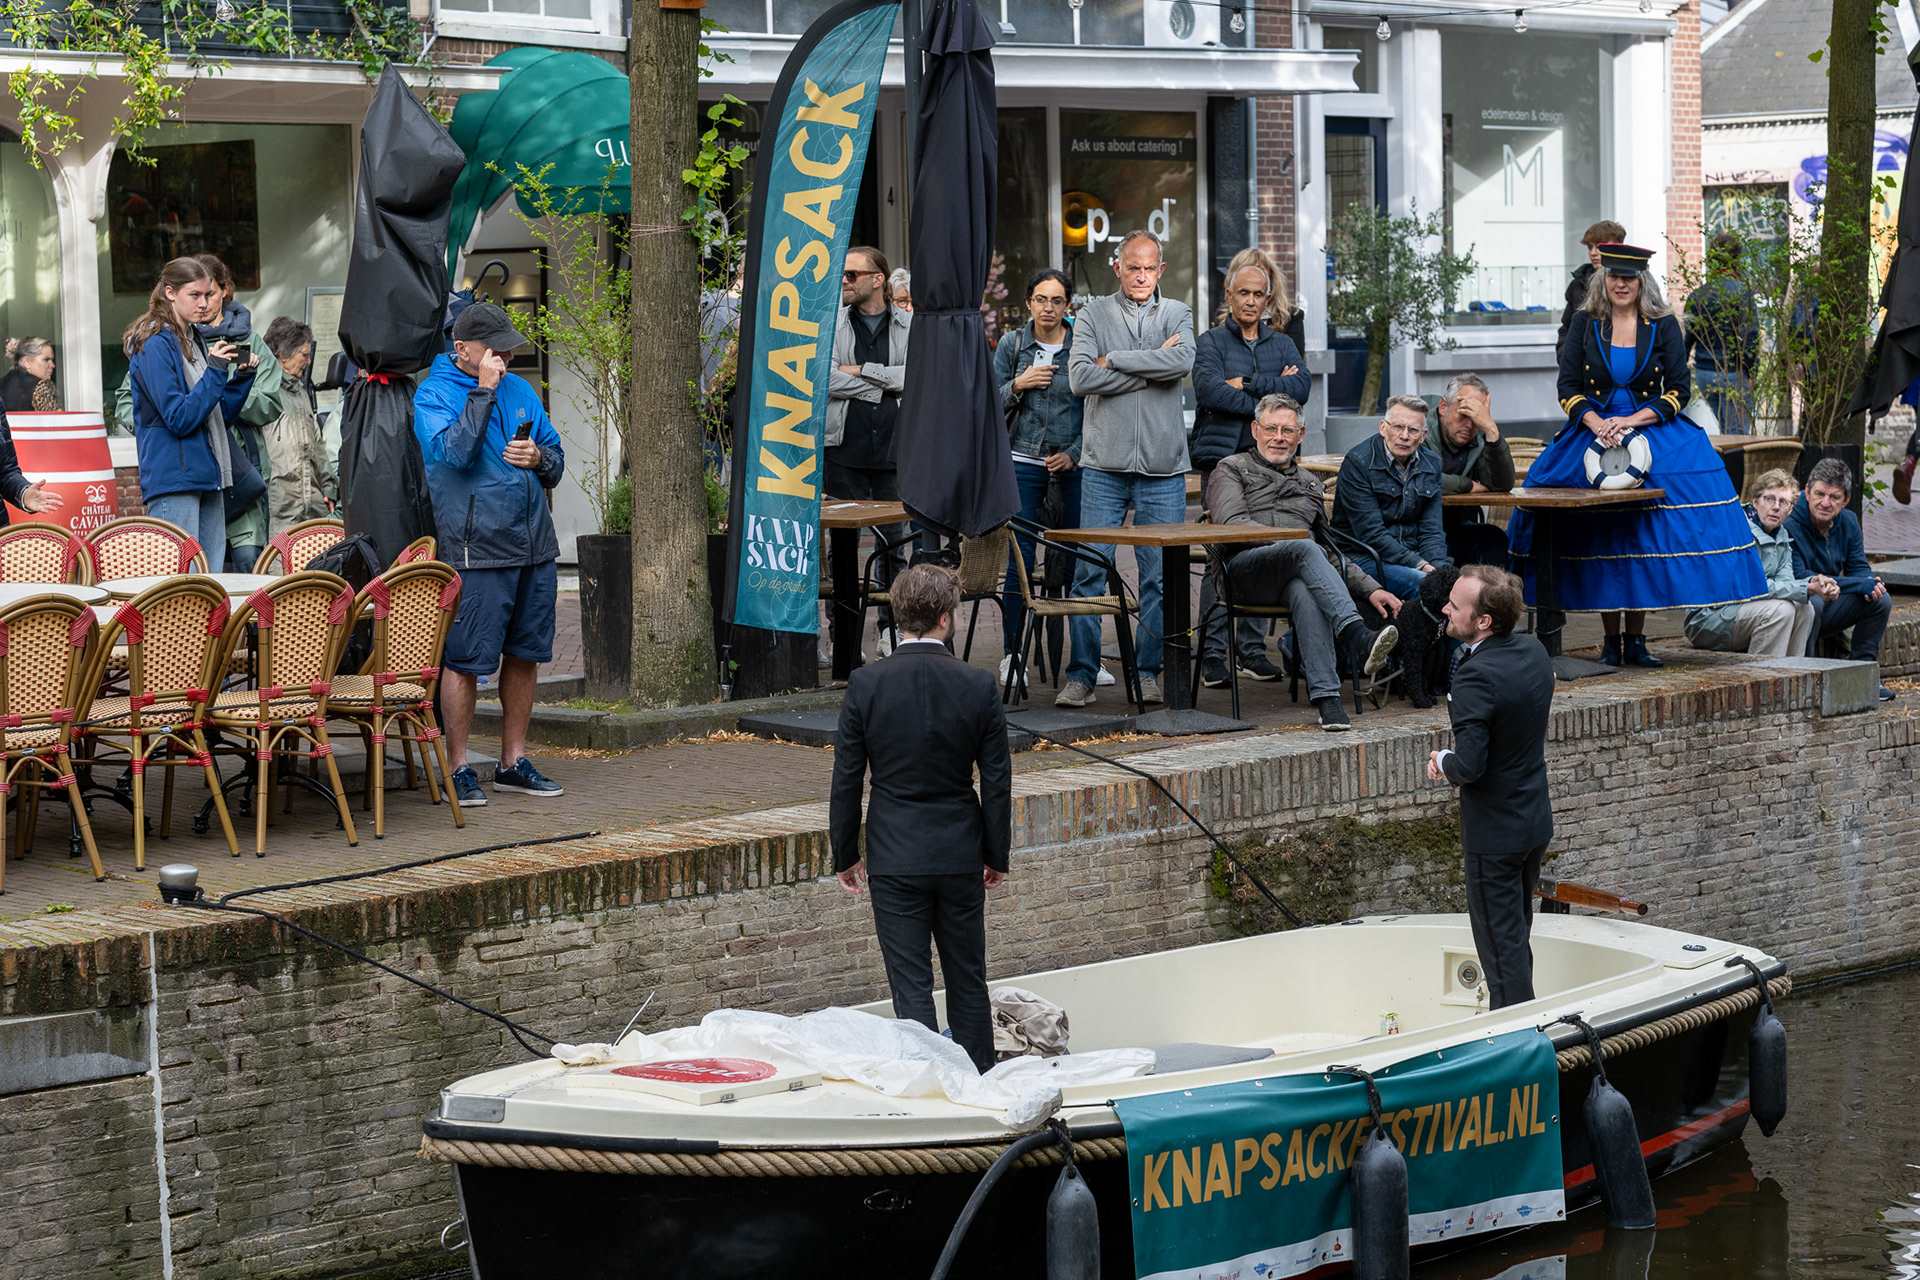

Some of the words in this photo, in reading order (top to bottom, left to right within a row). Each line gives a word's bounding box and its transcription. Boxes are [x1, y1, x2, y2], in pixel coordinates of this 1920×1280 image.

[1530, 110, 1537, 121] &
[1539, 110, 1564, 124] design
[1071, 139, 1091, 152] Ask
[1093, 141, 1105, 152] us
[1107, 139, 1136, 152] about
[1137, 140, 1177, 156] catering
[1503, 144, 1543, 206] M
[887, 186, 894, 206] 4
[757, 77, 866, 499] KNAPSACK
[81, 504, 111, 516] CHÂTEAU
